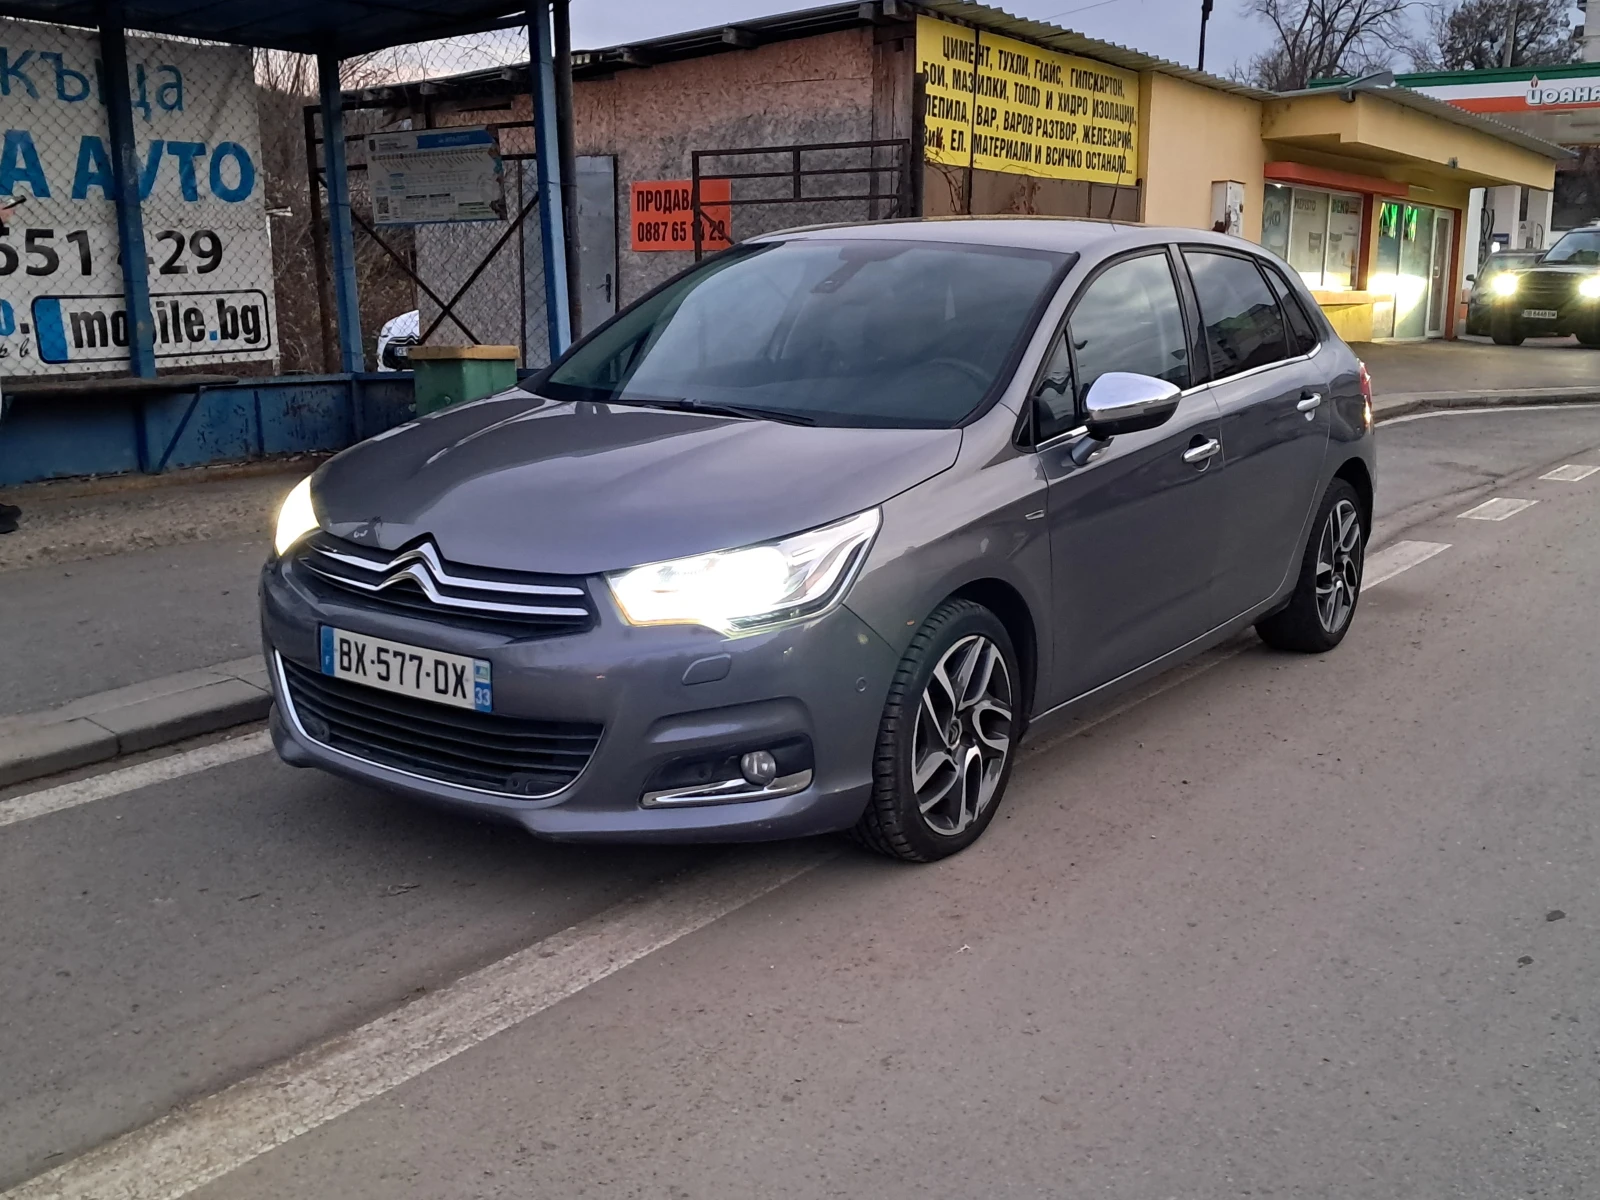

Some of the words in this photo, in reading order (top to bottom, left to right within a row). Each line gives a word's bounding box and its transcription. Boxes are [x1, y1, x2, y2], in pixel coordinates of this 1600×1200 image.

[943, 35, 993, 71] ЦИМЕНТ,
[998, 49, 1031, 80] ТУХЛИ,
[1070, 68, 1125, 99] ГИПСКАРТОН,
[952, 67, 1009, 103] МАЗИЛКИ,
[1045, 90, 1053, 110] И
[1057, 92, 1088, 117] ХИДРО
[1092, 98, 1137, 126] ИЗОЛАЦИИ,
[950, 129, 966, 152] ЕЛ.
[974, 133, 1032, 162] МАТЕРИАЛИ
[1034, 144, 1042, 164] И
[1045, 146, 1082, 169] ВСИЧКО
[976, 104, 999, 132] ВАР,
[1003, 110, 1034, 135] ВАРОВ
[1036, 118, 1079, 144] РАЗТВОР,
[1082, 124, 1134, 152] ЖЕЛЕЗАРИЯ,
[637, 221, 668, 242] 0887
[671, 221, 687, 241] 65
[70, 297, 261, 349] moile.bg
[475, 686, 491, 706] 33
